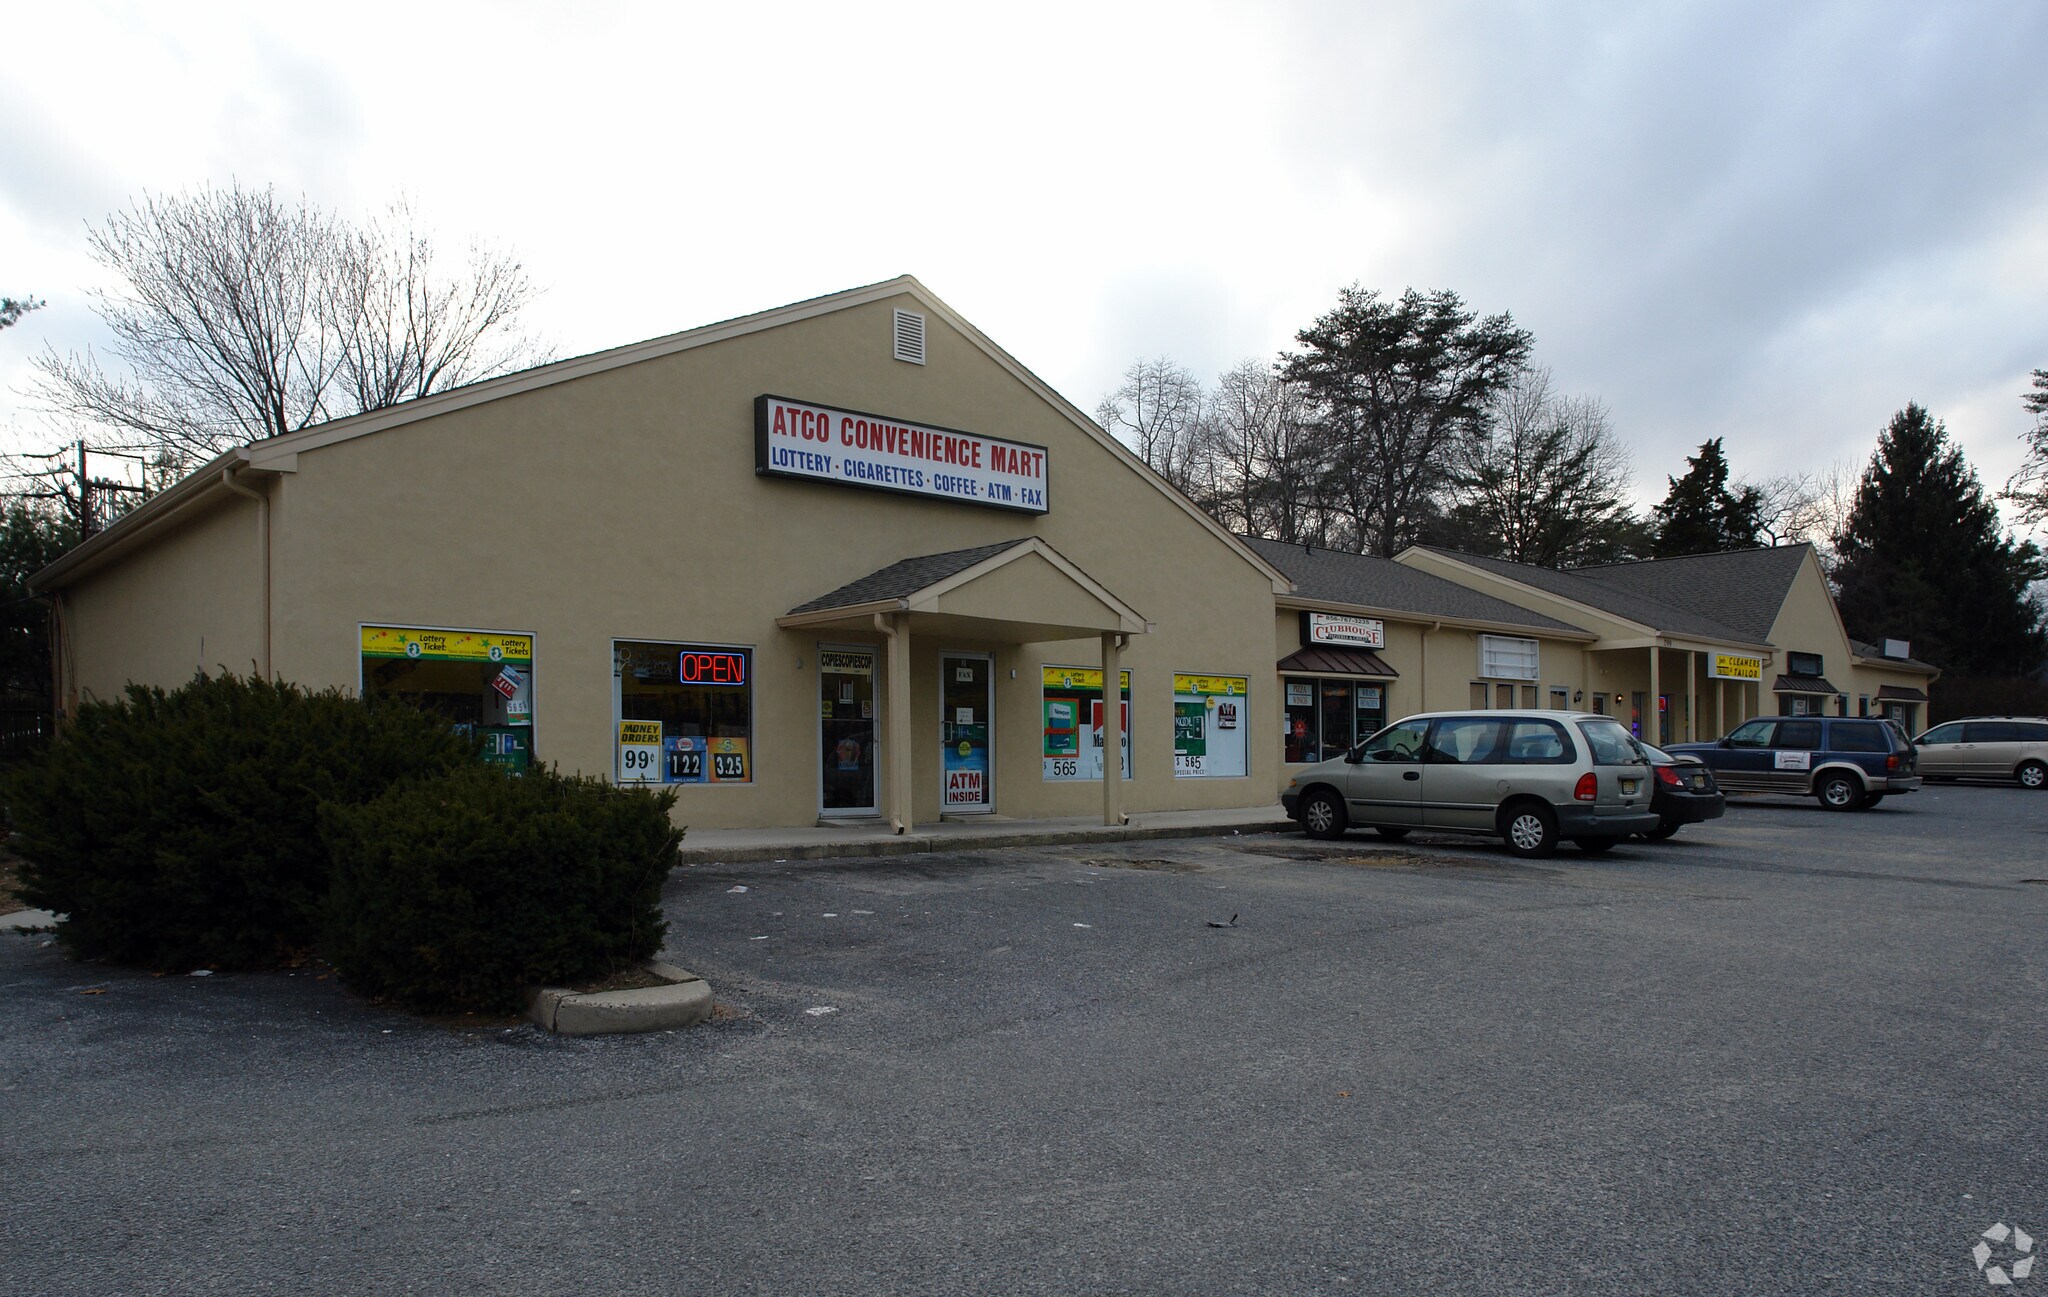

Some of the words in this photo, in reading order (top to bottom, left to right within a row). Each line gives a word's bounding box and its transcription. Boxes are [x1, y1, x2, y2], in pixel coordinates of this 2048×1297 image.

[772, 405, 830, 443] ATCO
[840, 416, 982, 469] CONVENIENCE
[991, 444, 1043, 479] MART
[771, 446, 832, 474] LOTTERY
[843, 458, 924, 488] CIGARETTES
[934, 473, 977, 496] COFFEE
[988, 482, 1012, 501] ATM
[1021, 487, 1042, 506] FAX
[1326, 615, 1370, 624] 856-767-3235
[419, 634, 446, 644] Lottery
[1315, 625, 1379, 644] CLUBHOUSE
[501, 639, 527, 649] Lottery
[505, 647, 529, 656] Tickets
[1729, 657, 1760, 668] CLEANERS
[682, 654, 743, 683] OPEN
[1734, 668, 1758, 678] TAILOR
[623, 724, 660, 734] MONEY
[621, 734, 659, 743] ORDERS
[949, 772, 980, 789] ATM
[949, 791, 981, 802] INSIDE
